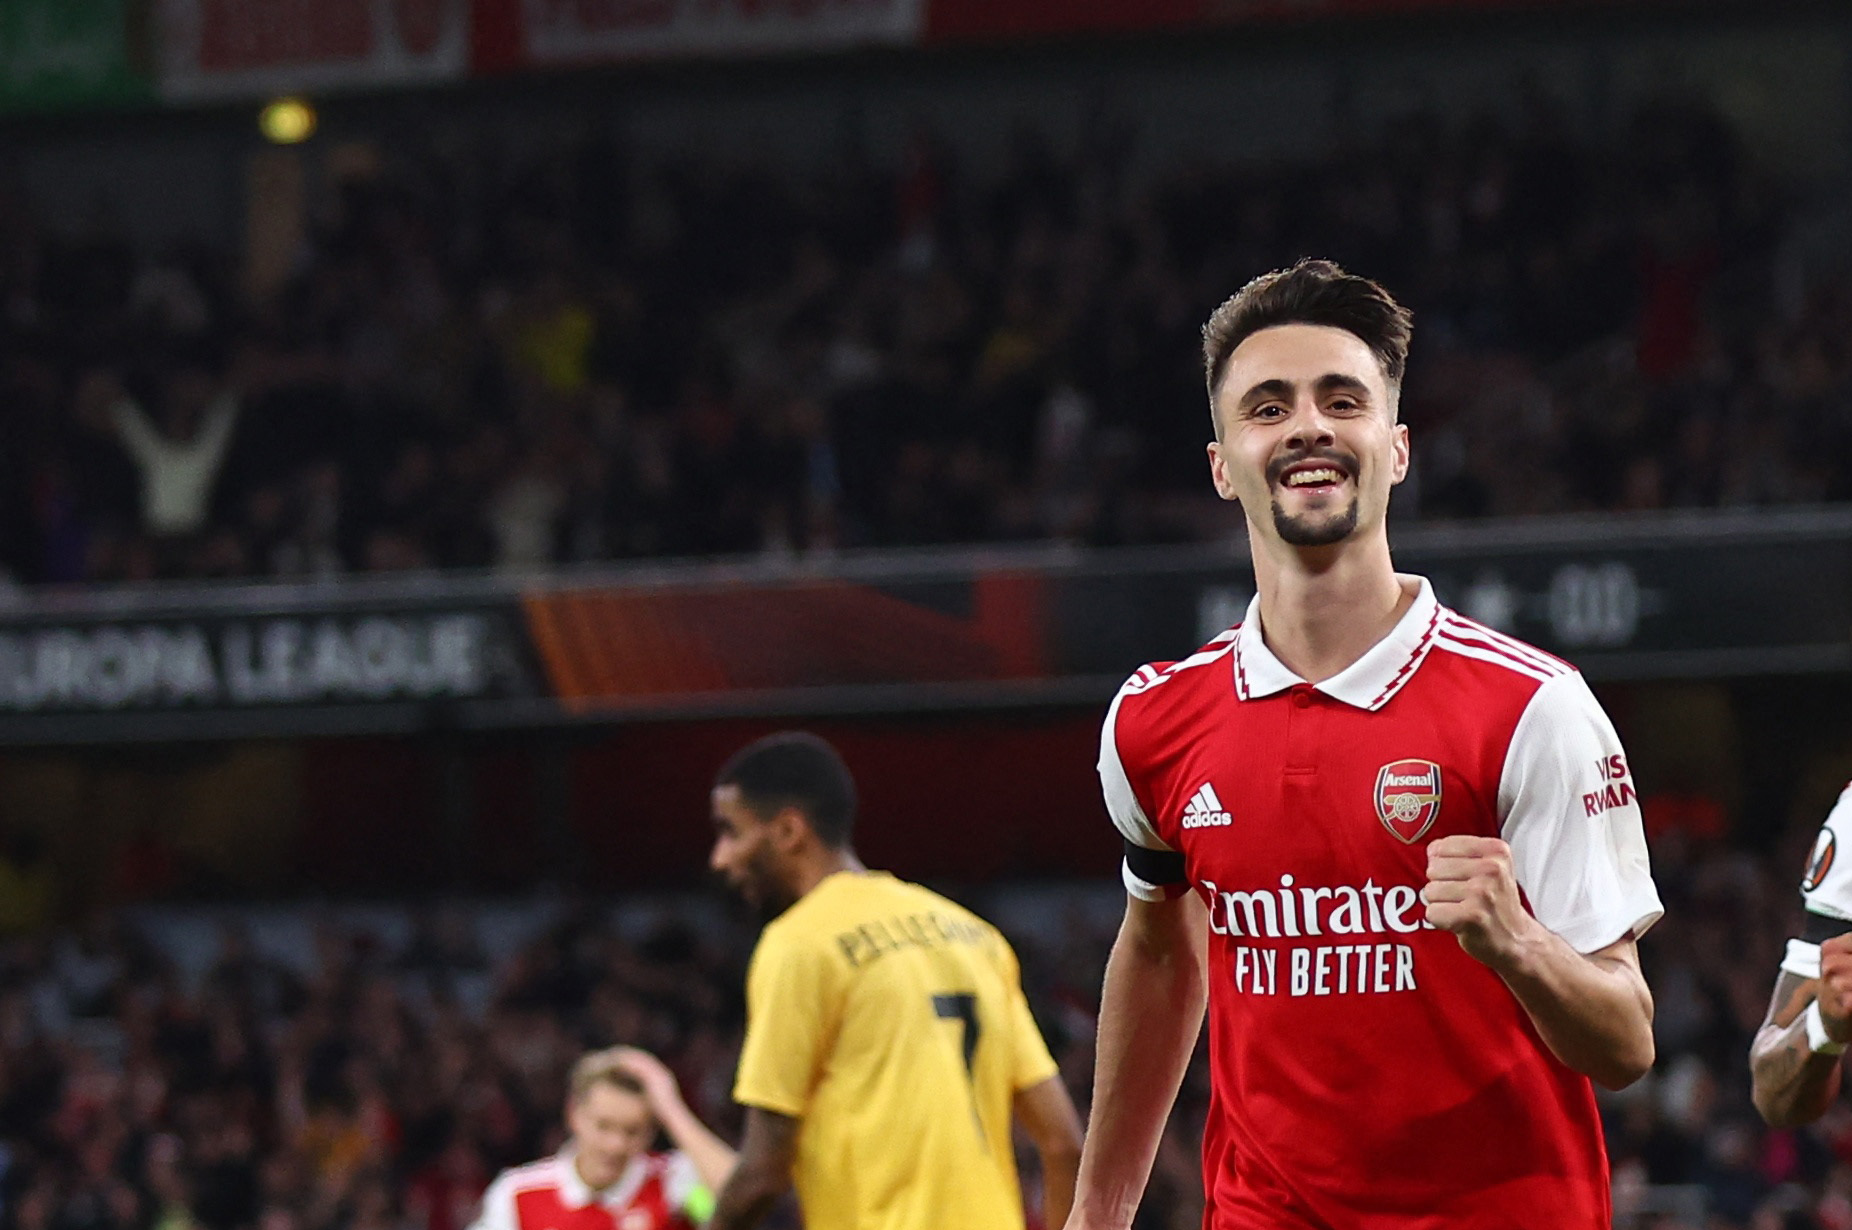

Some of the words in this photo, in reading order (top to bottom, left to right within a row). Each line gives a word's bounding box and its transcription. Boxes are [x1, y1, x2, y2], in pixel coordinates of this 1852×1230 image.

[222, 614, 486, 702] LEAGUE
[1384, 772, 1432, 787] Arsenal
[1595, 753, 1631, 782] VIS
[1182, 808, 1232, 829] adidas
[1235, 945, 1277, 996] FLY
[1291, 942, 1417, 997] BETTER
[932, 991, 981, 1084] 7
